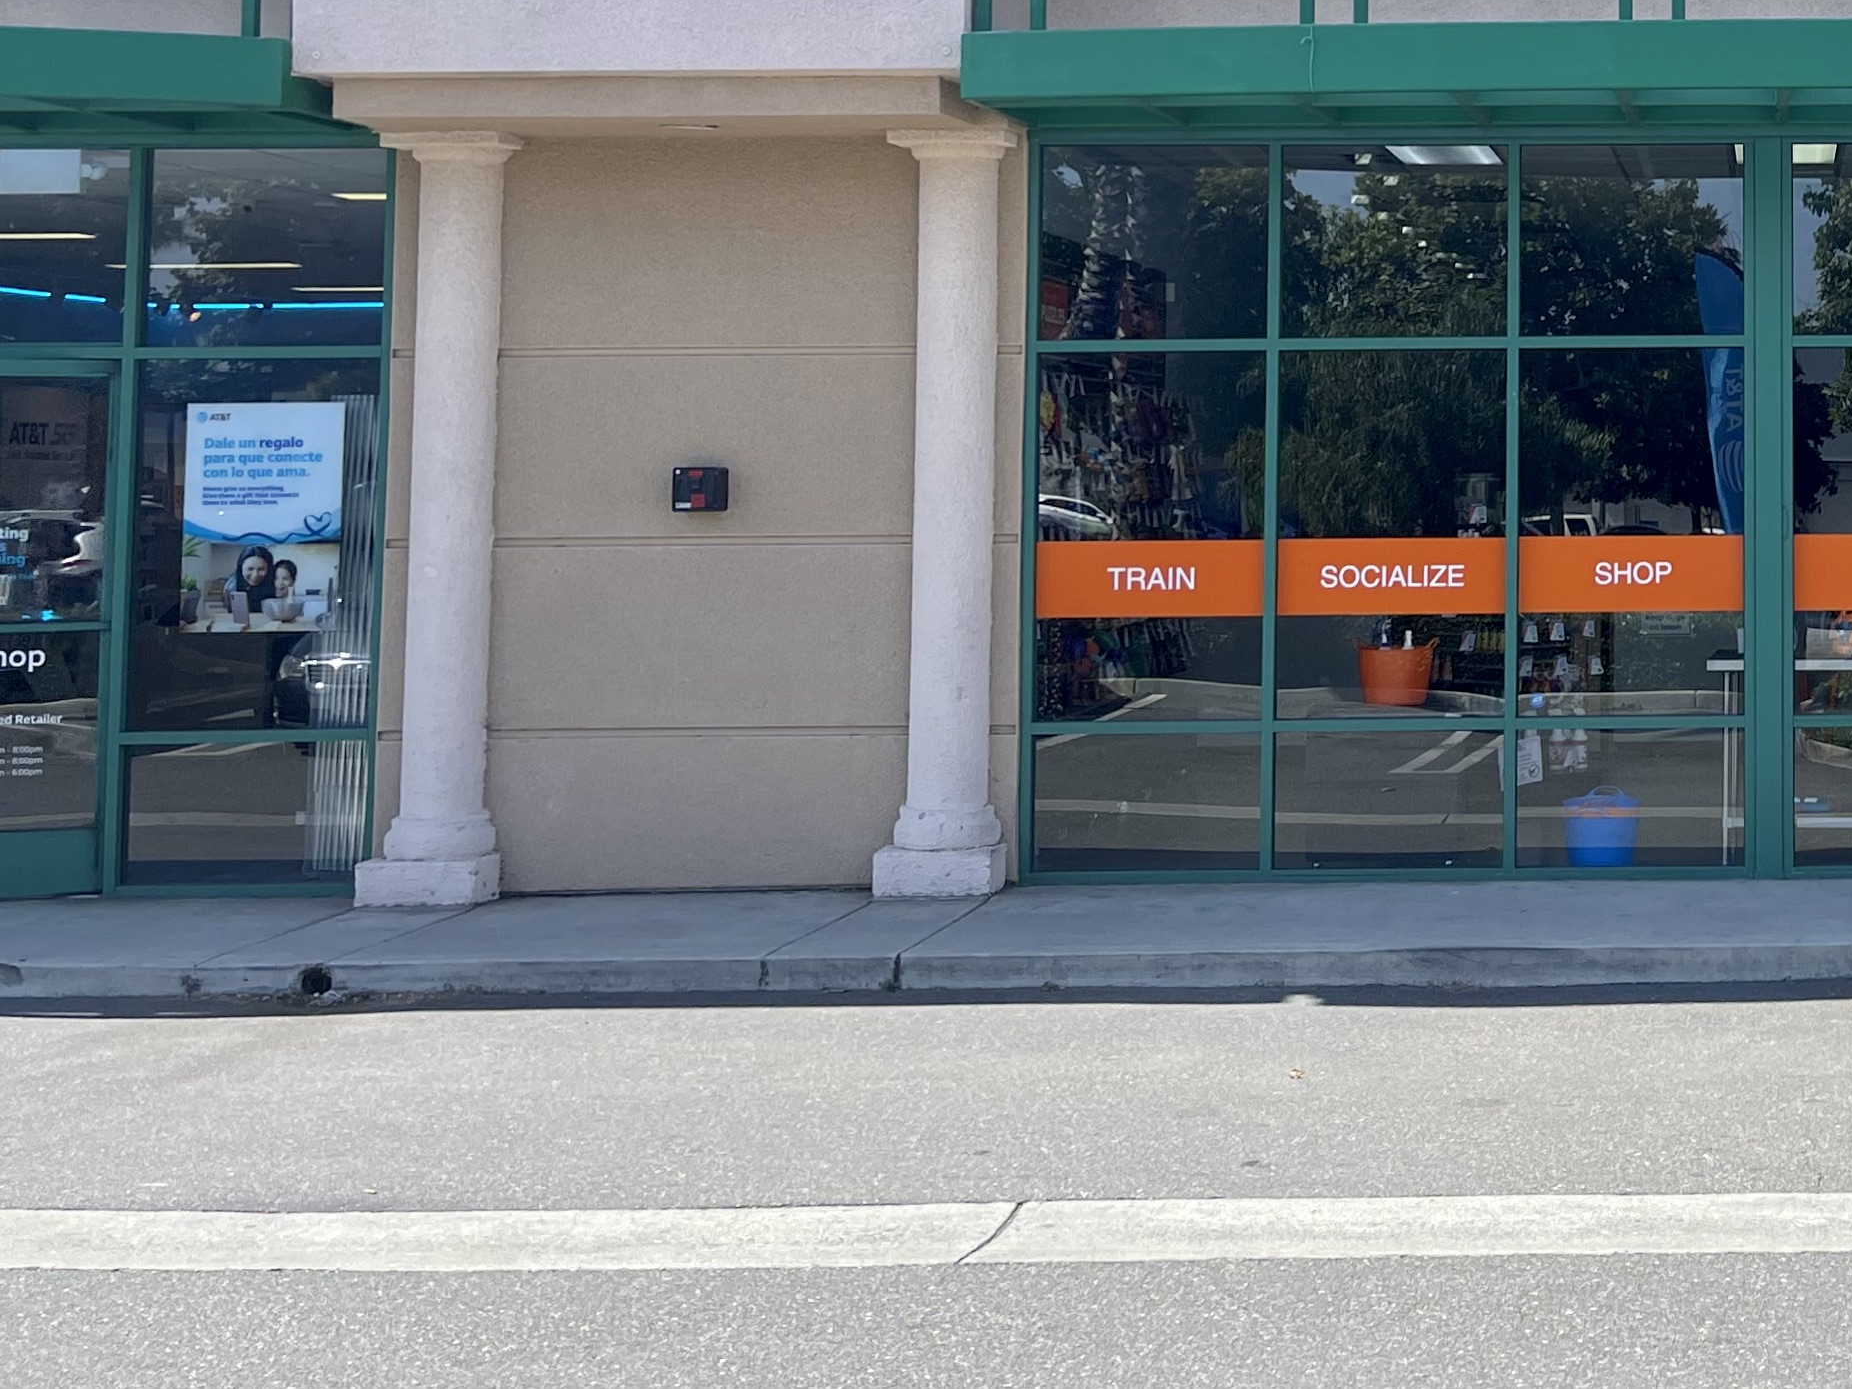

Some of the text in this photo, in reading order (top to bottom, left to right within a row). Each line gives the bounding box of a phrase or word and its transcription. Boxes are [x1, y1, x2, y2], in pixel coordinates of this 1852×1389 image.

[209, 413, 231, 421] AT&T
[9, 422, 49, 445] AT&T
[204, 436, 304, 451] Dale un regalo
[204, 451, 323, 466] para que conecte
[203, 467, 310, 479] con lo que ama.
[0, 553, 26, 568] ing
[1107, 566, 1196, 591] TRAIN
[1320, 564, 1465, 589] SOCIALIZE
[1594, 561, 1673, 586] SHOP
[15, 714, 63, 724] Retailer
